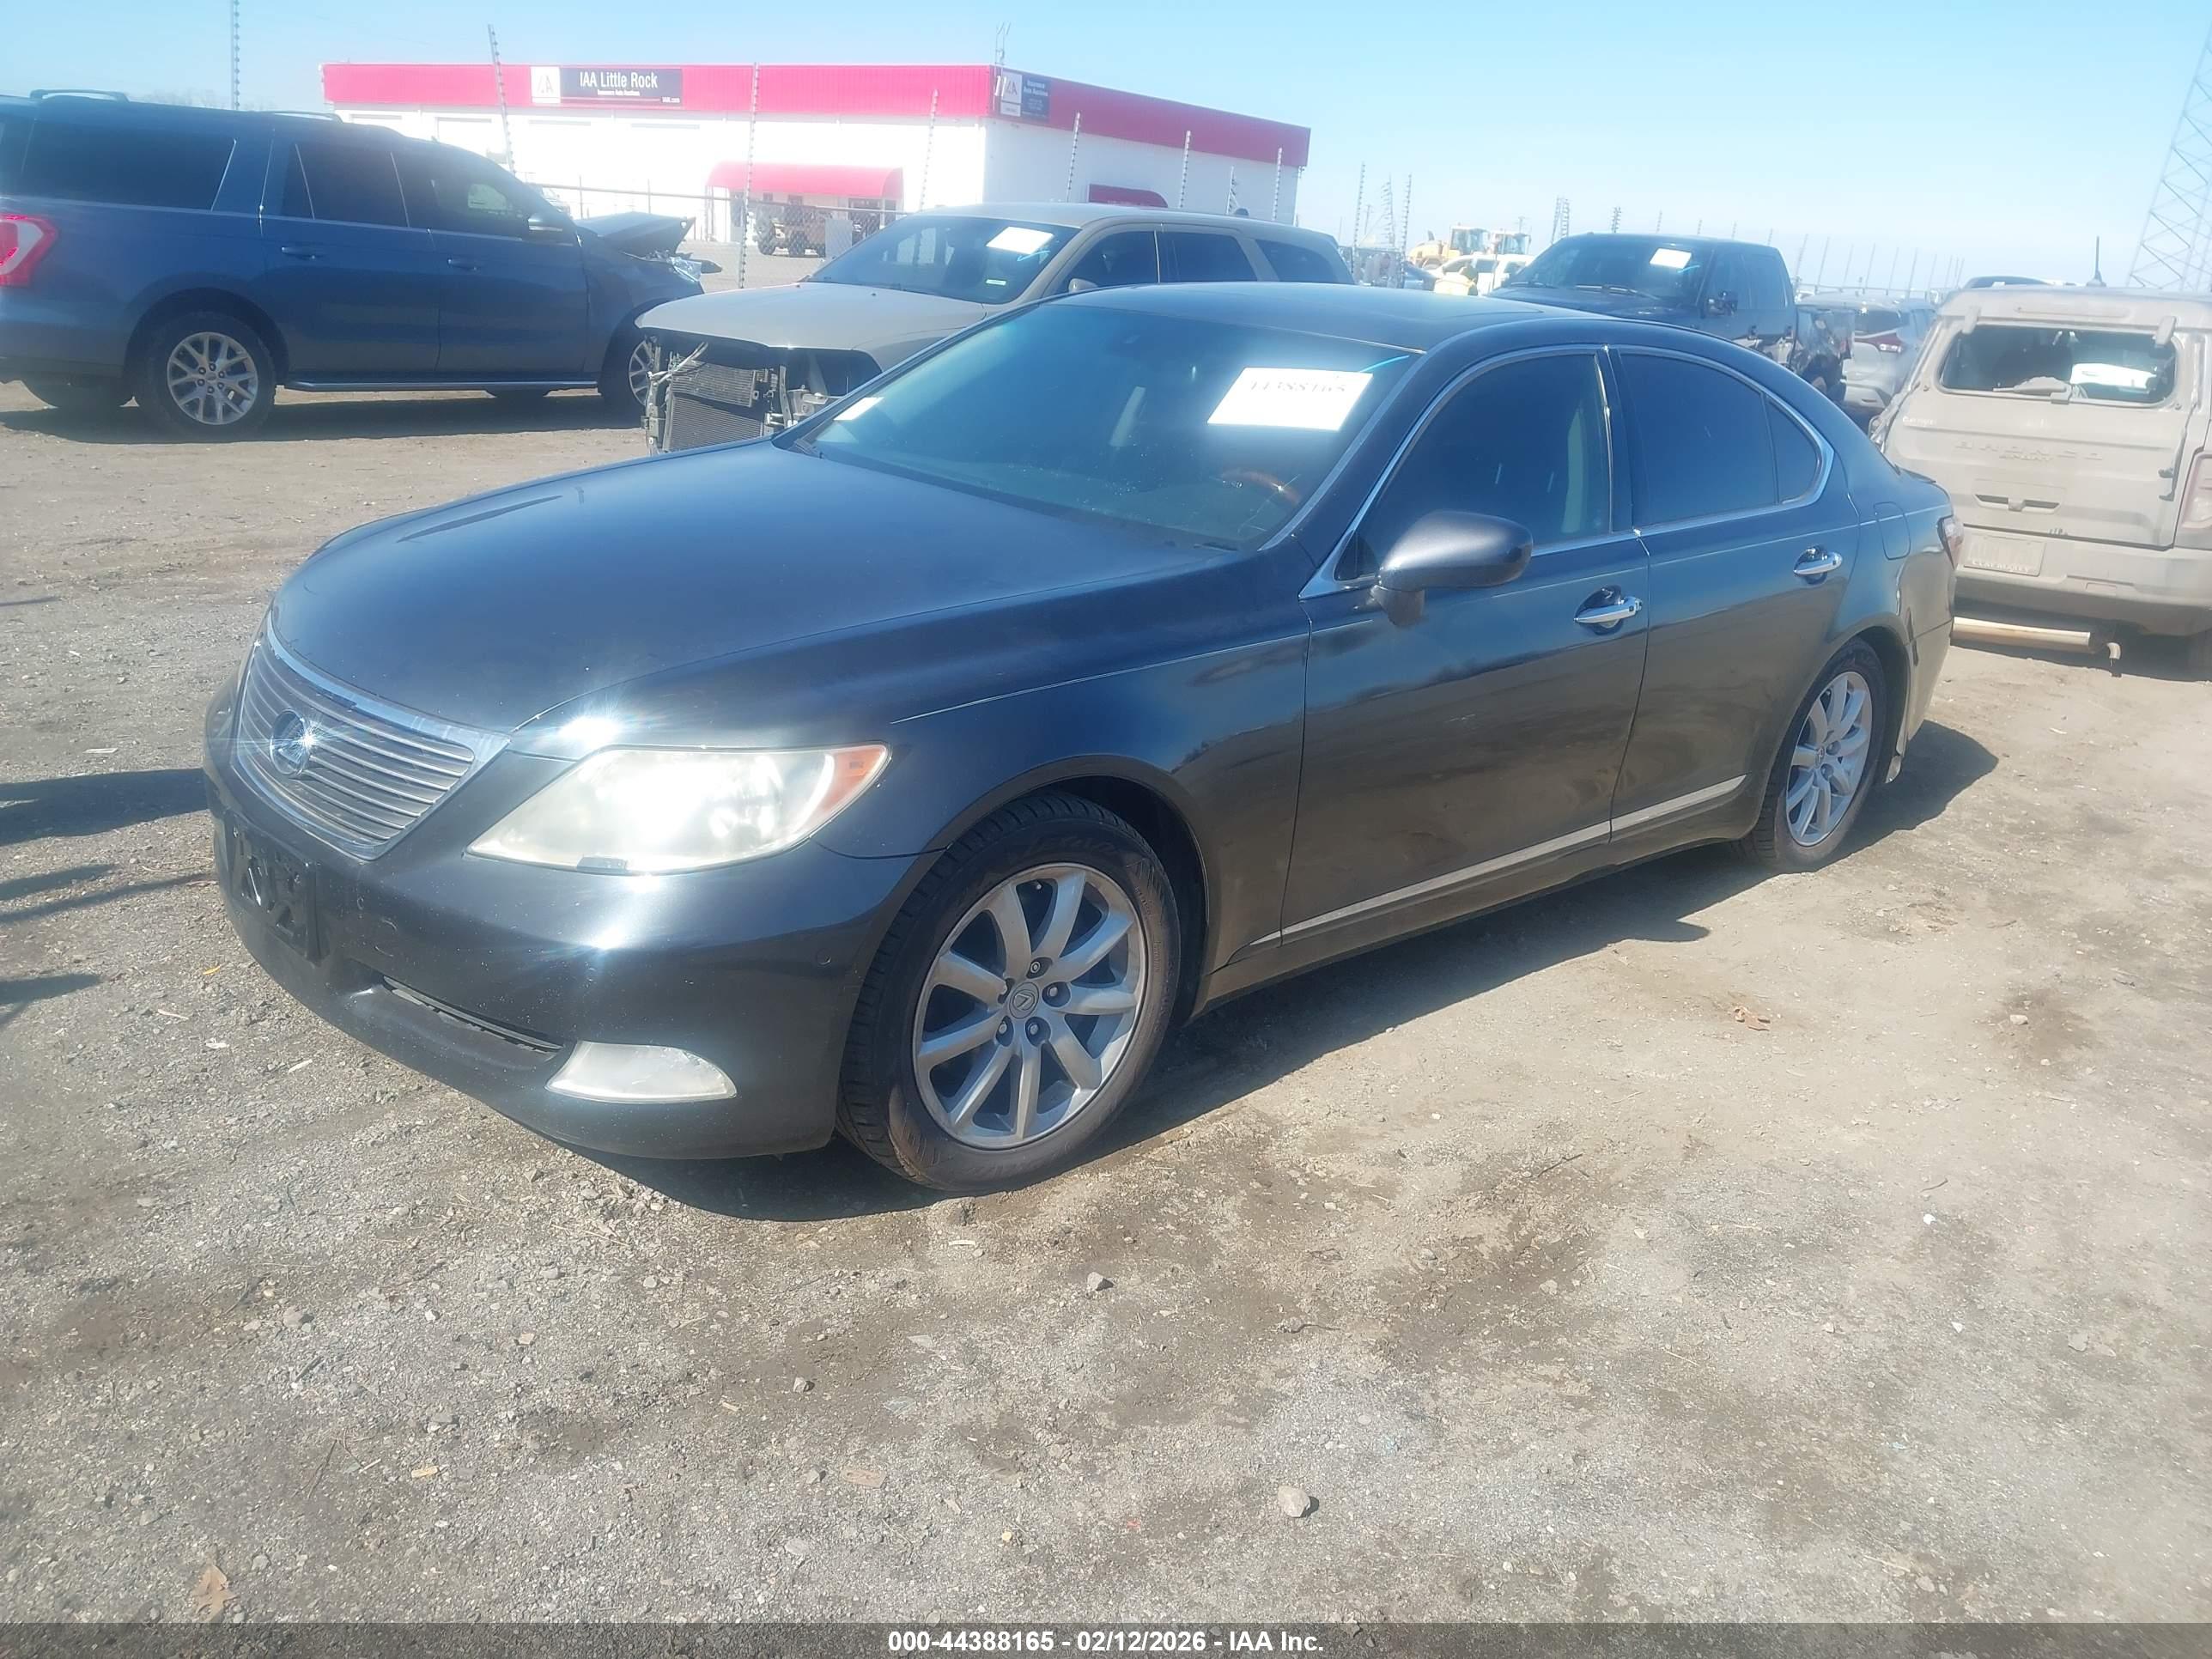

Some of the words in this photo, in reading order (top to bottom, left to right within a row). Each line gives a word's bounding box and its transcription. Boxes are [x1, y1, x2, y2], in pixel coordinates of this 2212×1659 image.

[580, 71, 598, 88] IAA
[600, 71, 628, 88] Little
[630, 71, 659, 89] Rock
